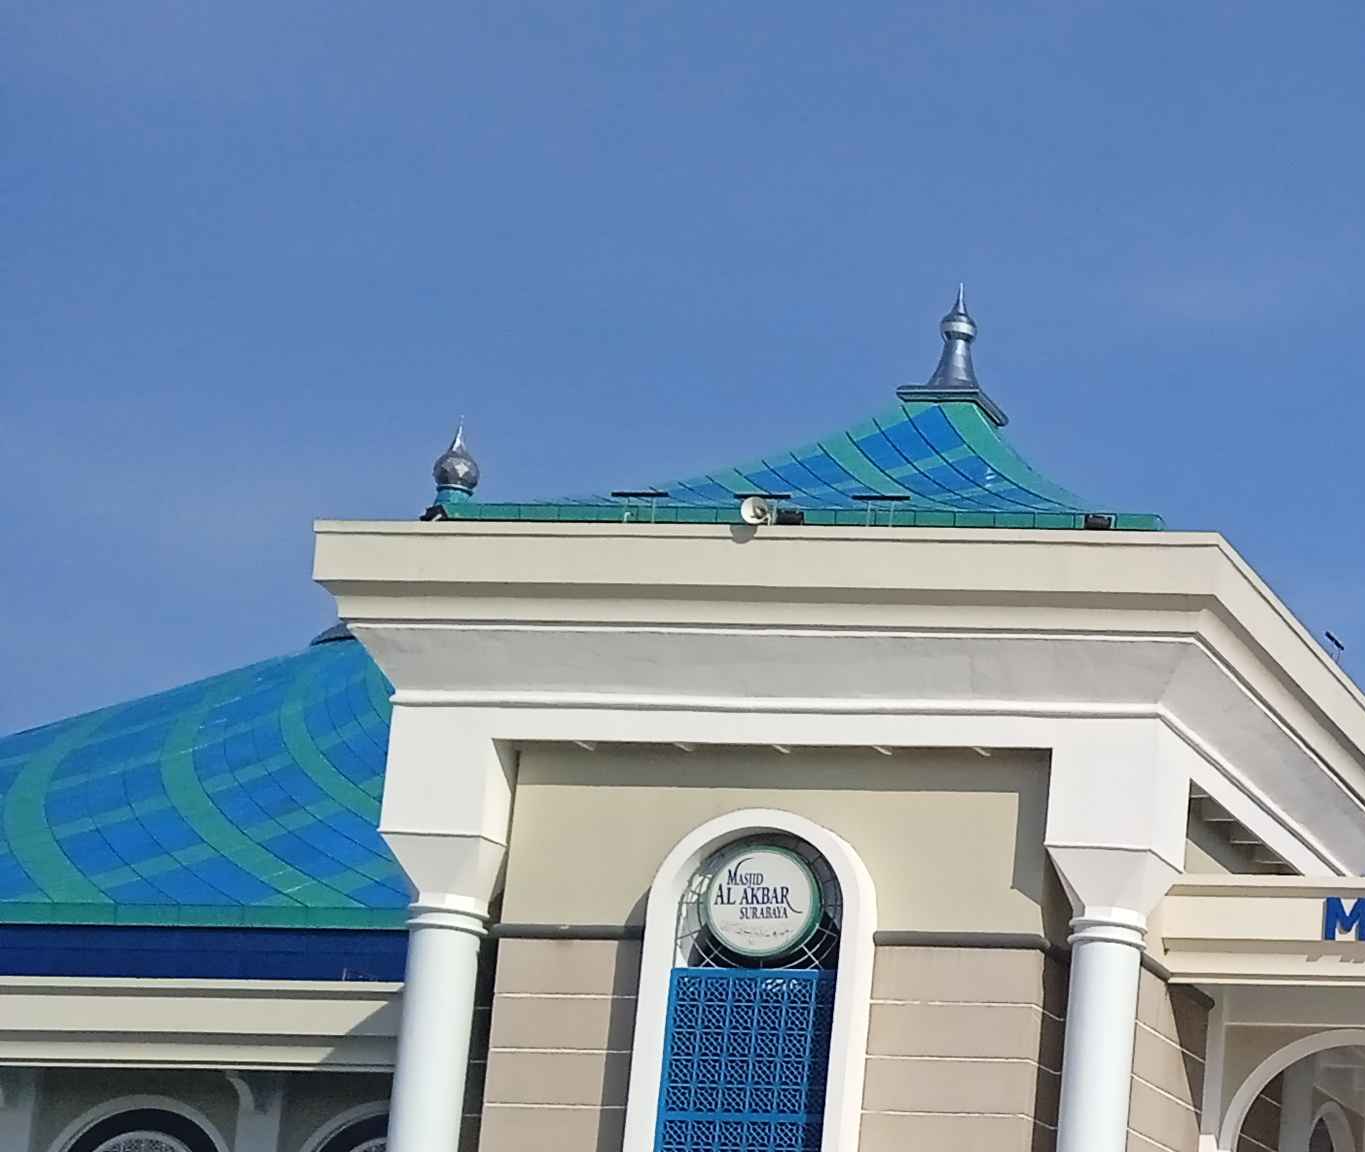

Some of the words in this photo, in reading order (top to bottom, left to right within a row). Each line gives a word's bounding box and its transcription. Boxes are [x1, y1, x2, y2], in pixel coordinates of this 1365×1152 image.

[727, 861, 764, 887] MASJID
[713, 884, 736, 906] AL
[739, 886, 799, 911] AKBAR
[739, 905, 789, 920] SURABAYA
